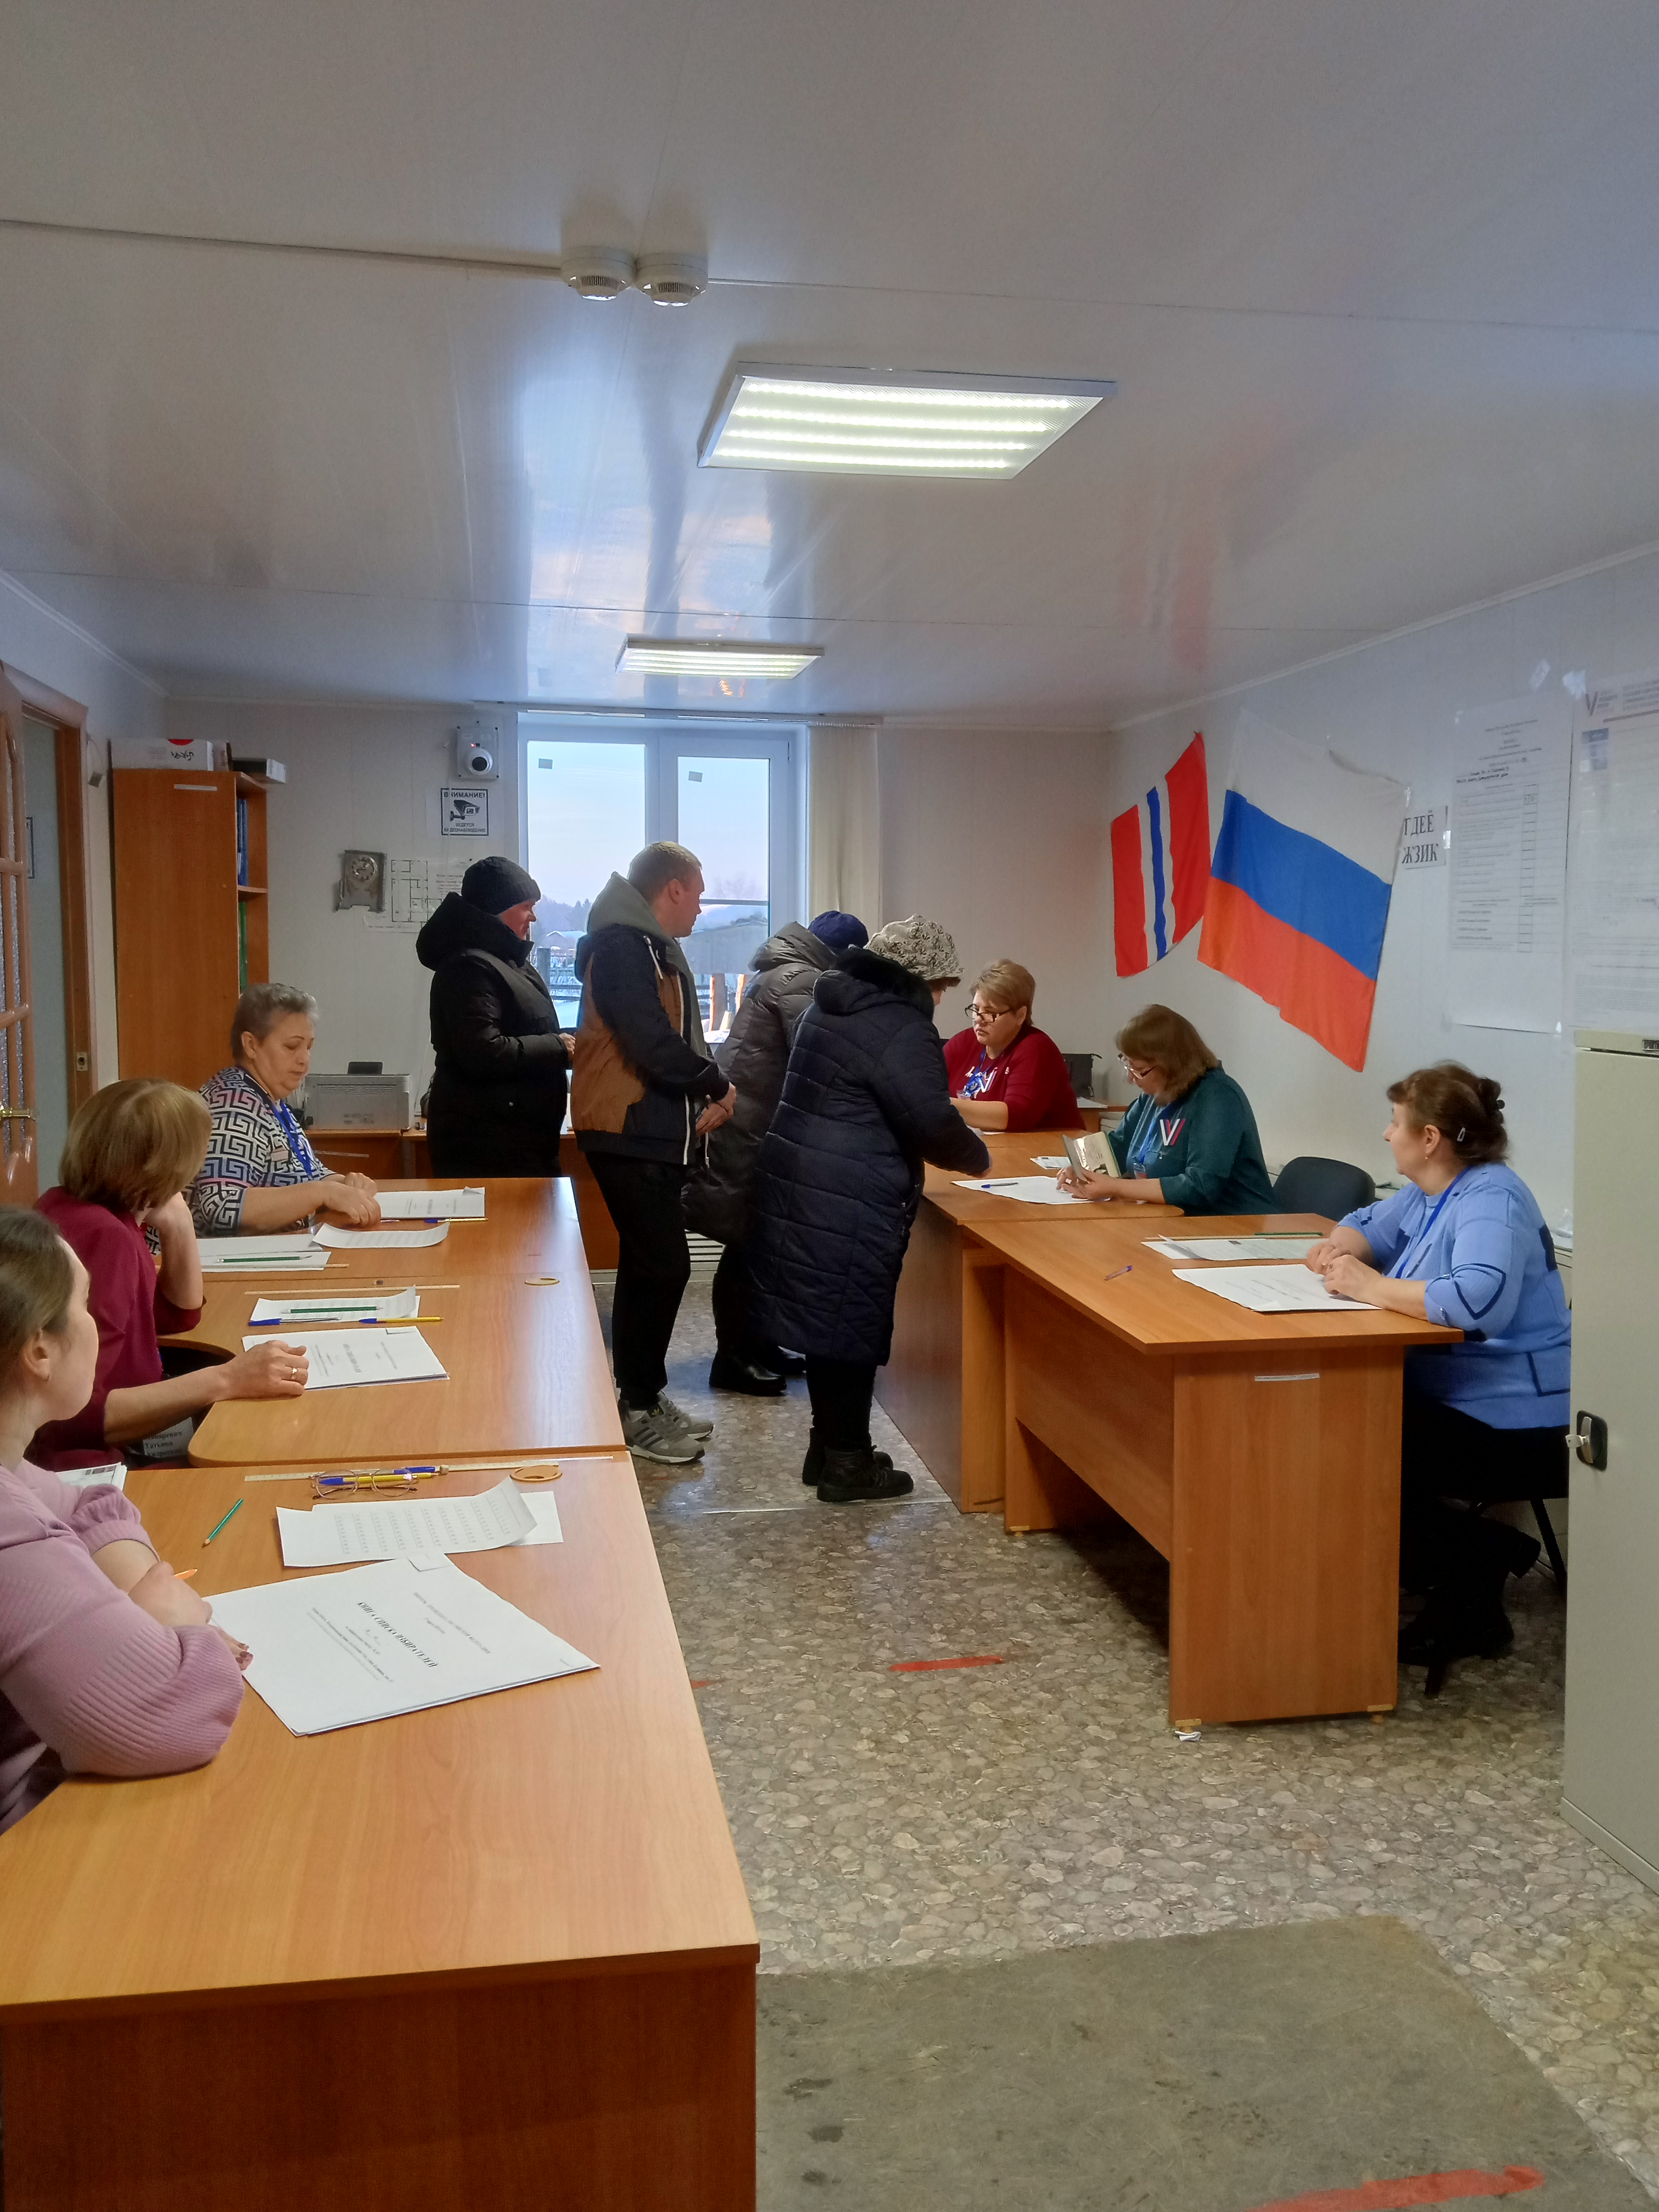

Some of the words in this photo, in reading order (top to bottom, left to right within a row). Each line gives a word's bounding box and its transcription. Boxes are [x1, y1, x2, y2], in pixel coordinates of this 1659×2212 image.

[1404, 810, 1434, 836] ГДЕЁ
[1402, 843, 1439, 864] ЖЗИК
[357, 1601, 376, 1617] КНИГА
[374, 1617, 397, 1635] СПИСКА
